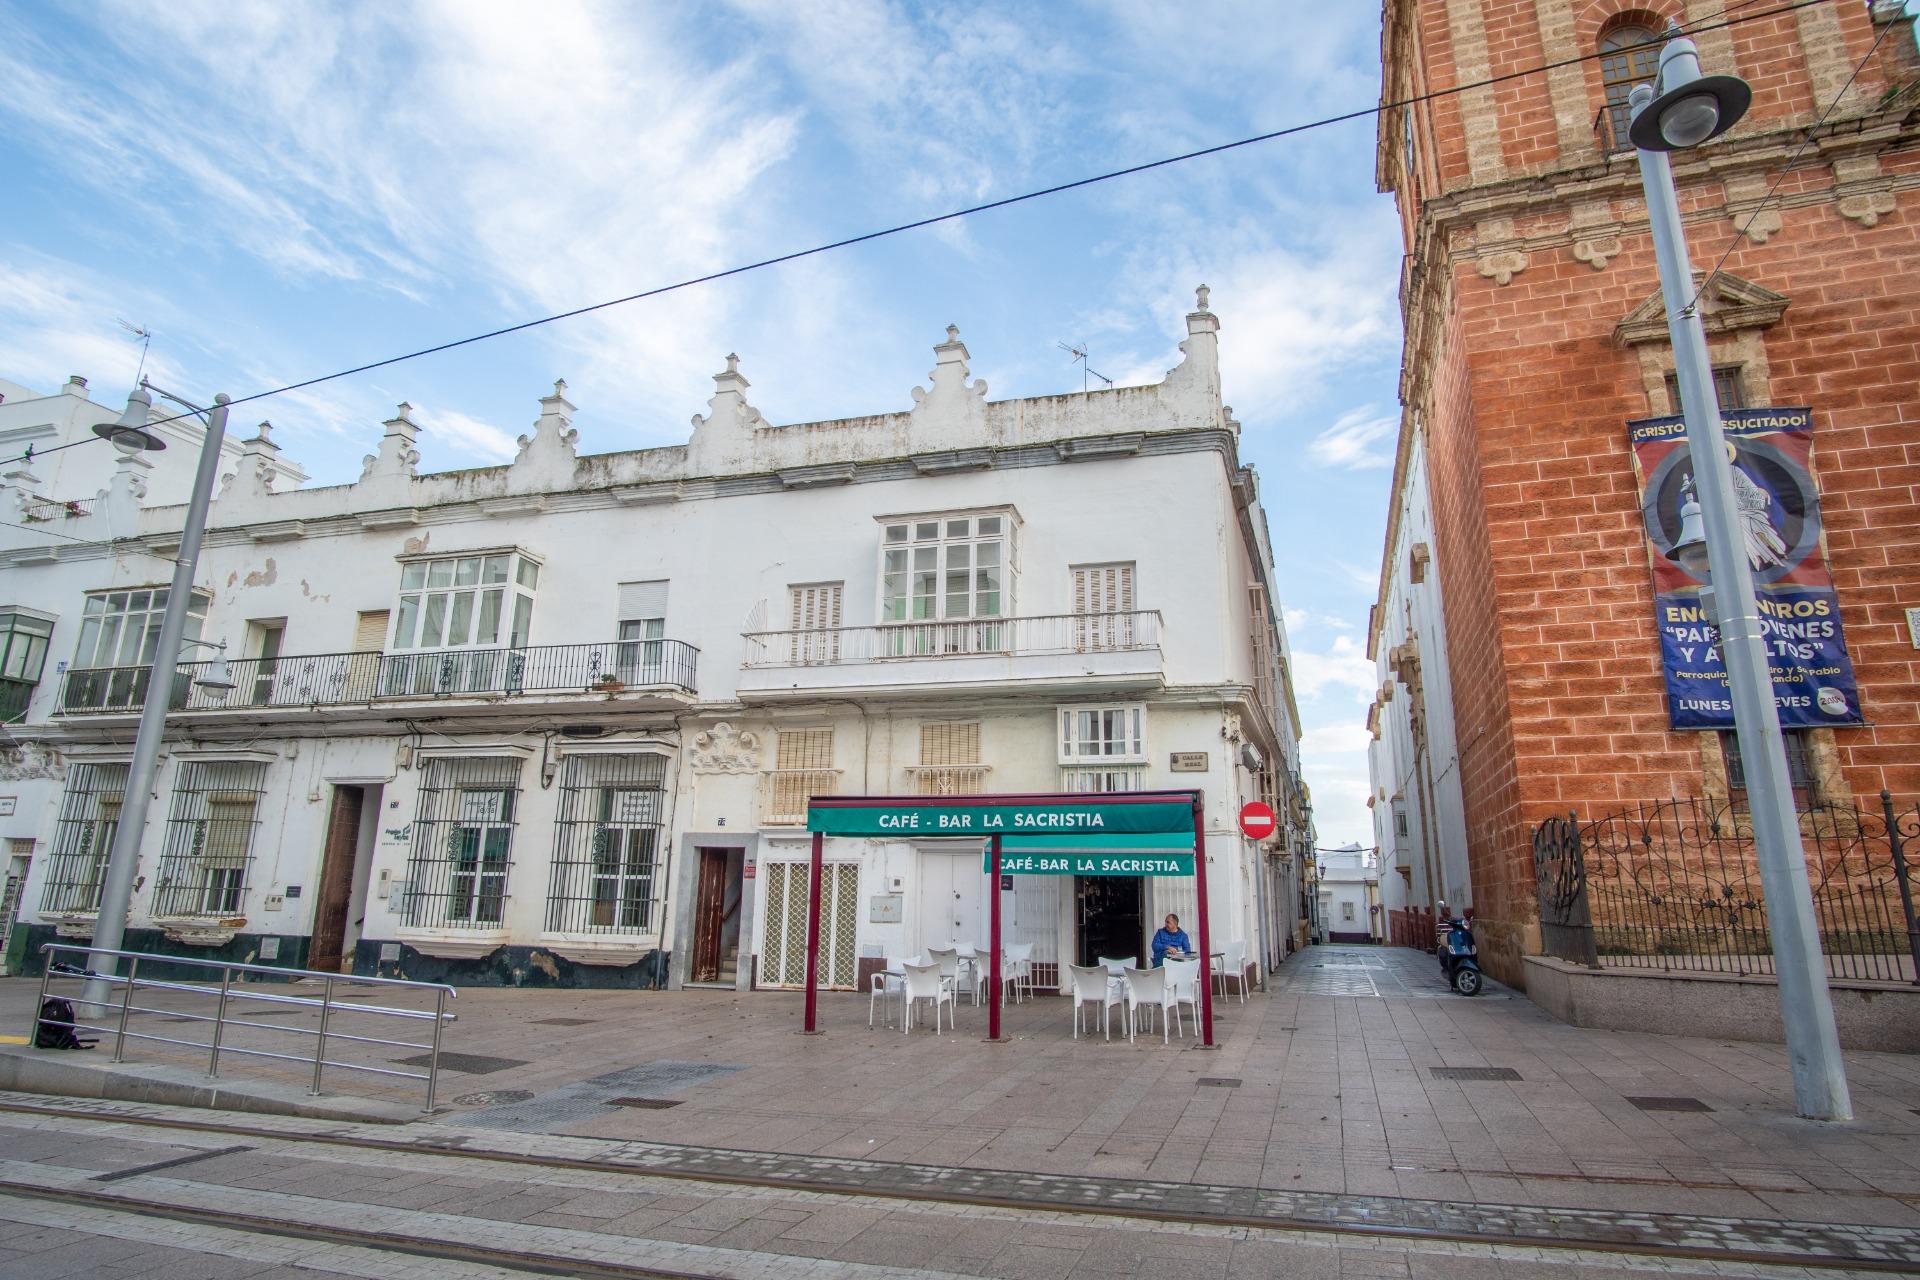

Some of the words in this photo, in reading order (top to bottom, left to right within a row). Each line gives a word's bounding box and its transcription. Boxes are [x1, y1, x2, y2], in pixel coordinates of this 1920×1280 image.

[1633, 423, 1685, 441] ¡CRISTO
[1720, 414, 1807, 430] ESUCITADO!
[1759, 616, 1834, 639] ÓVENES
[1680, 647, 1695, 663] Y
[1676, 671, 1727, 680] Parroquia
[1679, 699, 1732, 711] LUNES
[1774, 696, 1812, 708] EVES
[879, 813, 919, 829] CAFÉ
[939, 815, 972, 828] BAR
[983, 814, 1003, 828] LA
[1014, 813, 1105, 828] SACRISTIA
[1077, 859, 1095, 871] LA
[1101, 860, 1180, 872] SACRISTIA
